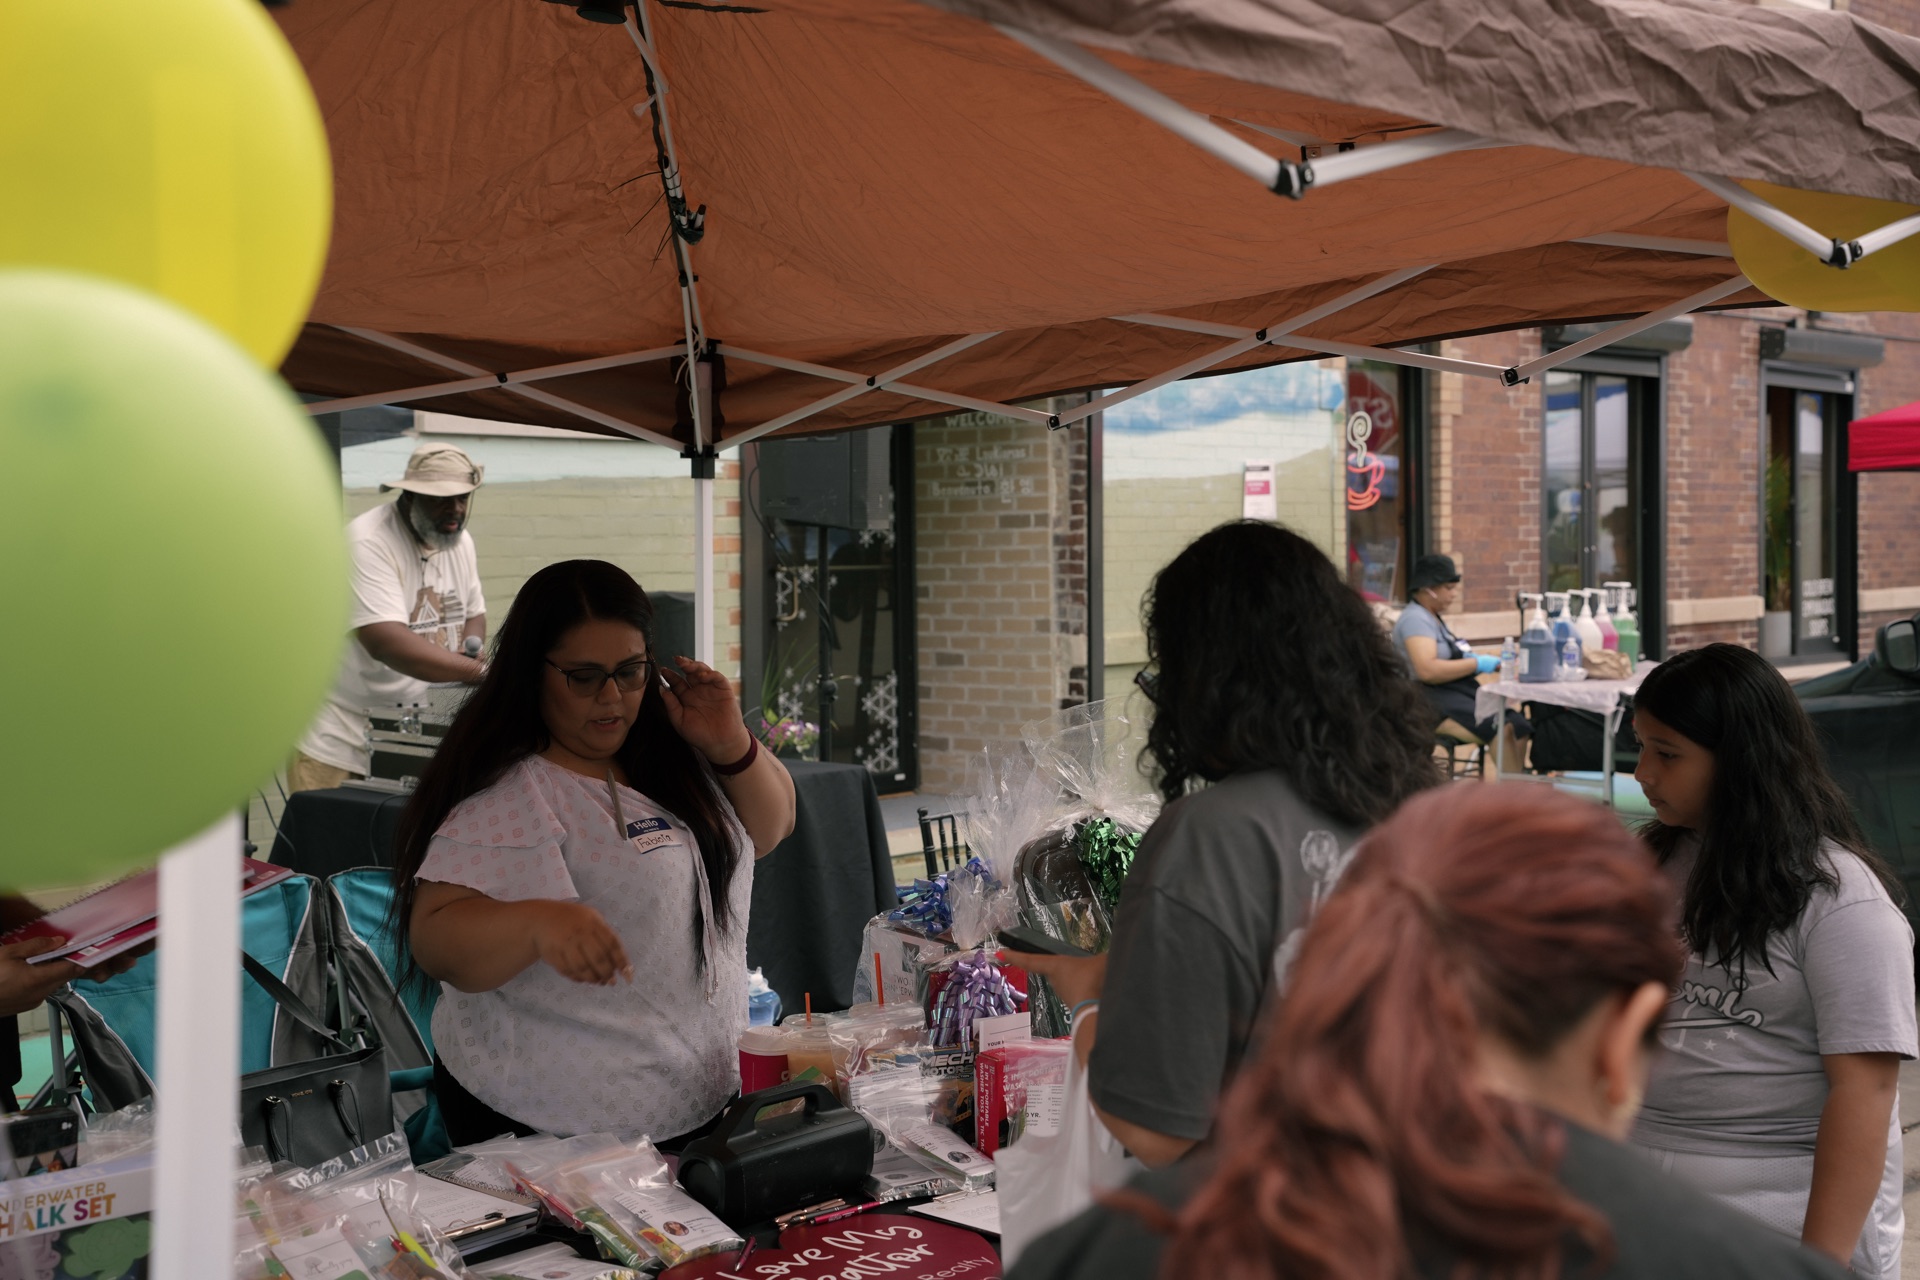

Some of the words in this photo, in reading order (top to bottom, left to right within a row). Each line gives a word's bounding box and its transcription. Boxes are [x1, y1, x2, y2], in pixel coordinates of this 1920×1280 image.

[633, 819, 659, 830] Hello
[920, 1052, 974, 1067] MECH
[920, 1064, 974, 1077] MOTORS
[0, 1182, 107, 1213] NDERWATER
[0, 1203, 67, 1238] HALK
[73, 1193, 117, 1222] SET
[821, 1225, 923, 1251] My
[787, 1243, 935, 1280] altor
[916, 1256, 995, 1280] Realty
